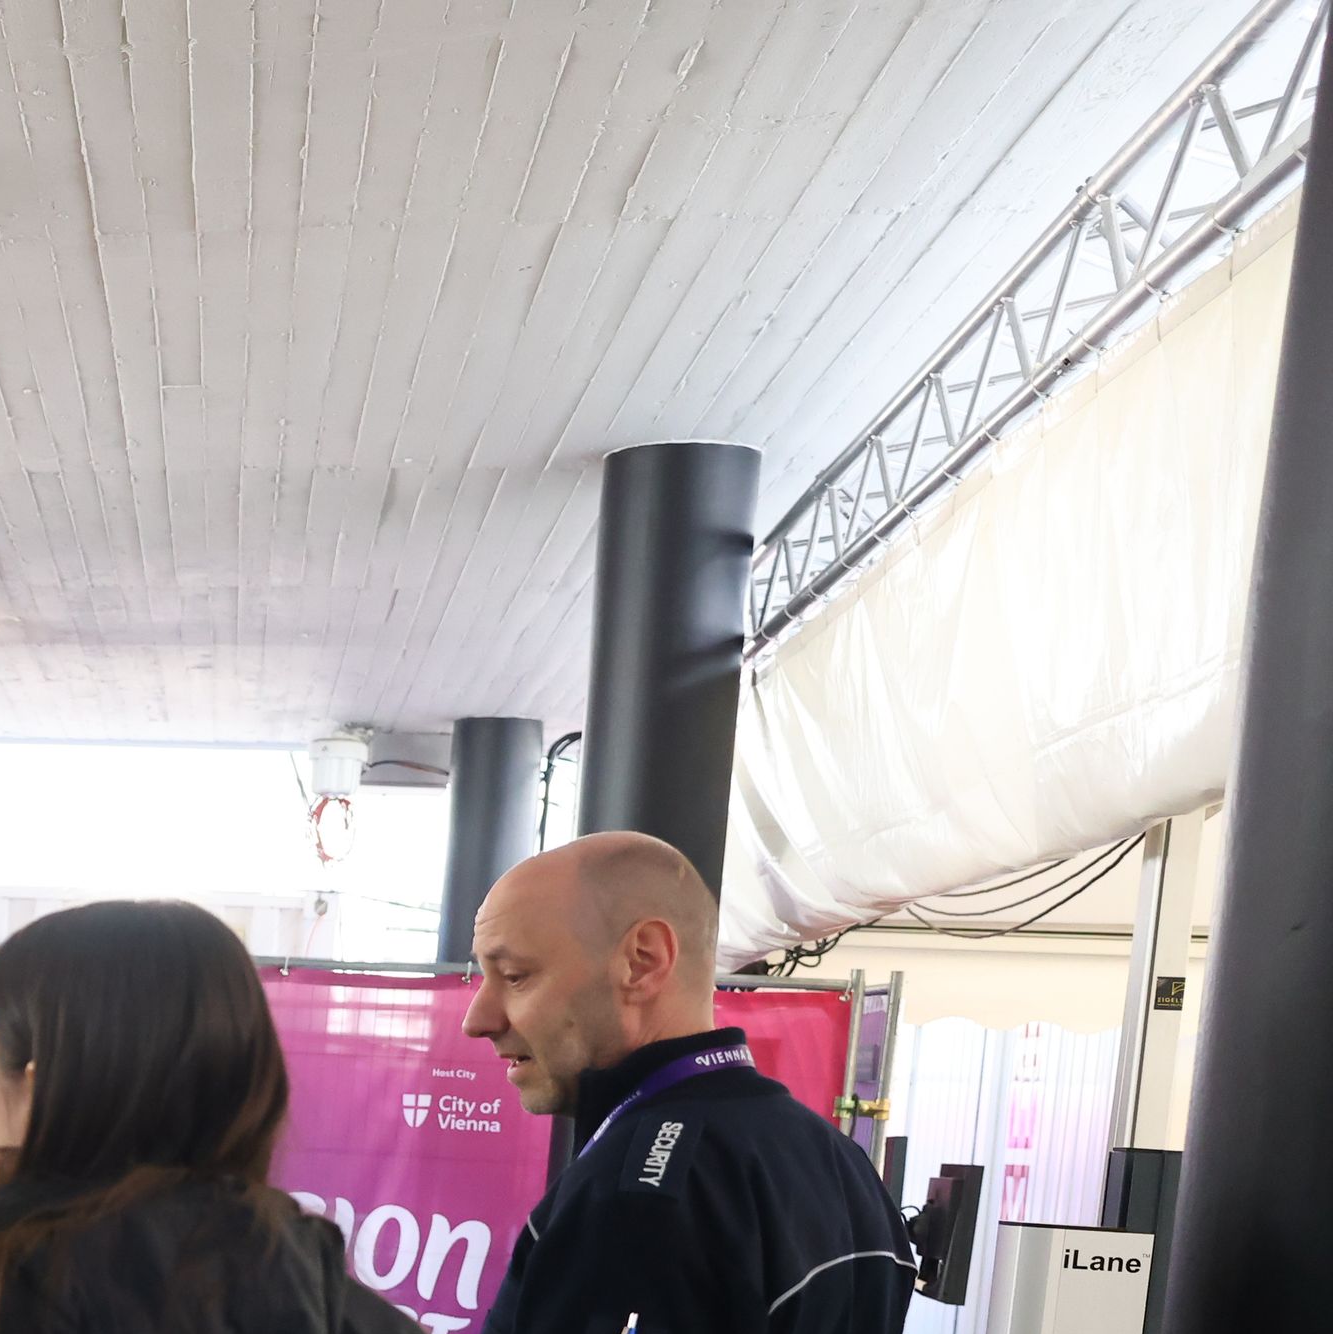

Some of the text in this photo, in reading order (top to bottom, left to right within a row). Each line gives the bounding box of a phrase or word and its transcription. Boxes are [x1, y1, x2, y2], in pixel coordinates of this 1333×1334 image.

[432, 1068, 477, 1080] Host City
[438, 1095, 501, 1117] City of
[437, 1113, 501, 1132] Vienna
[638, 1121, 683, 1187] SECURITY
[1063, 1248, 1141, 1274] iLane
